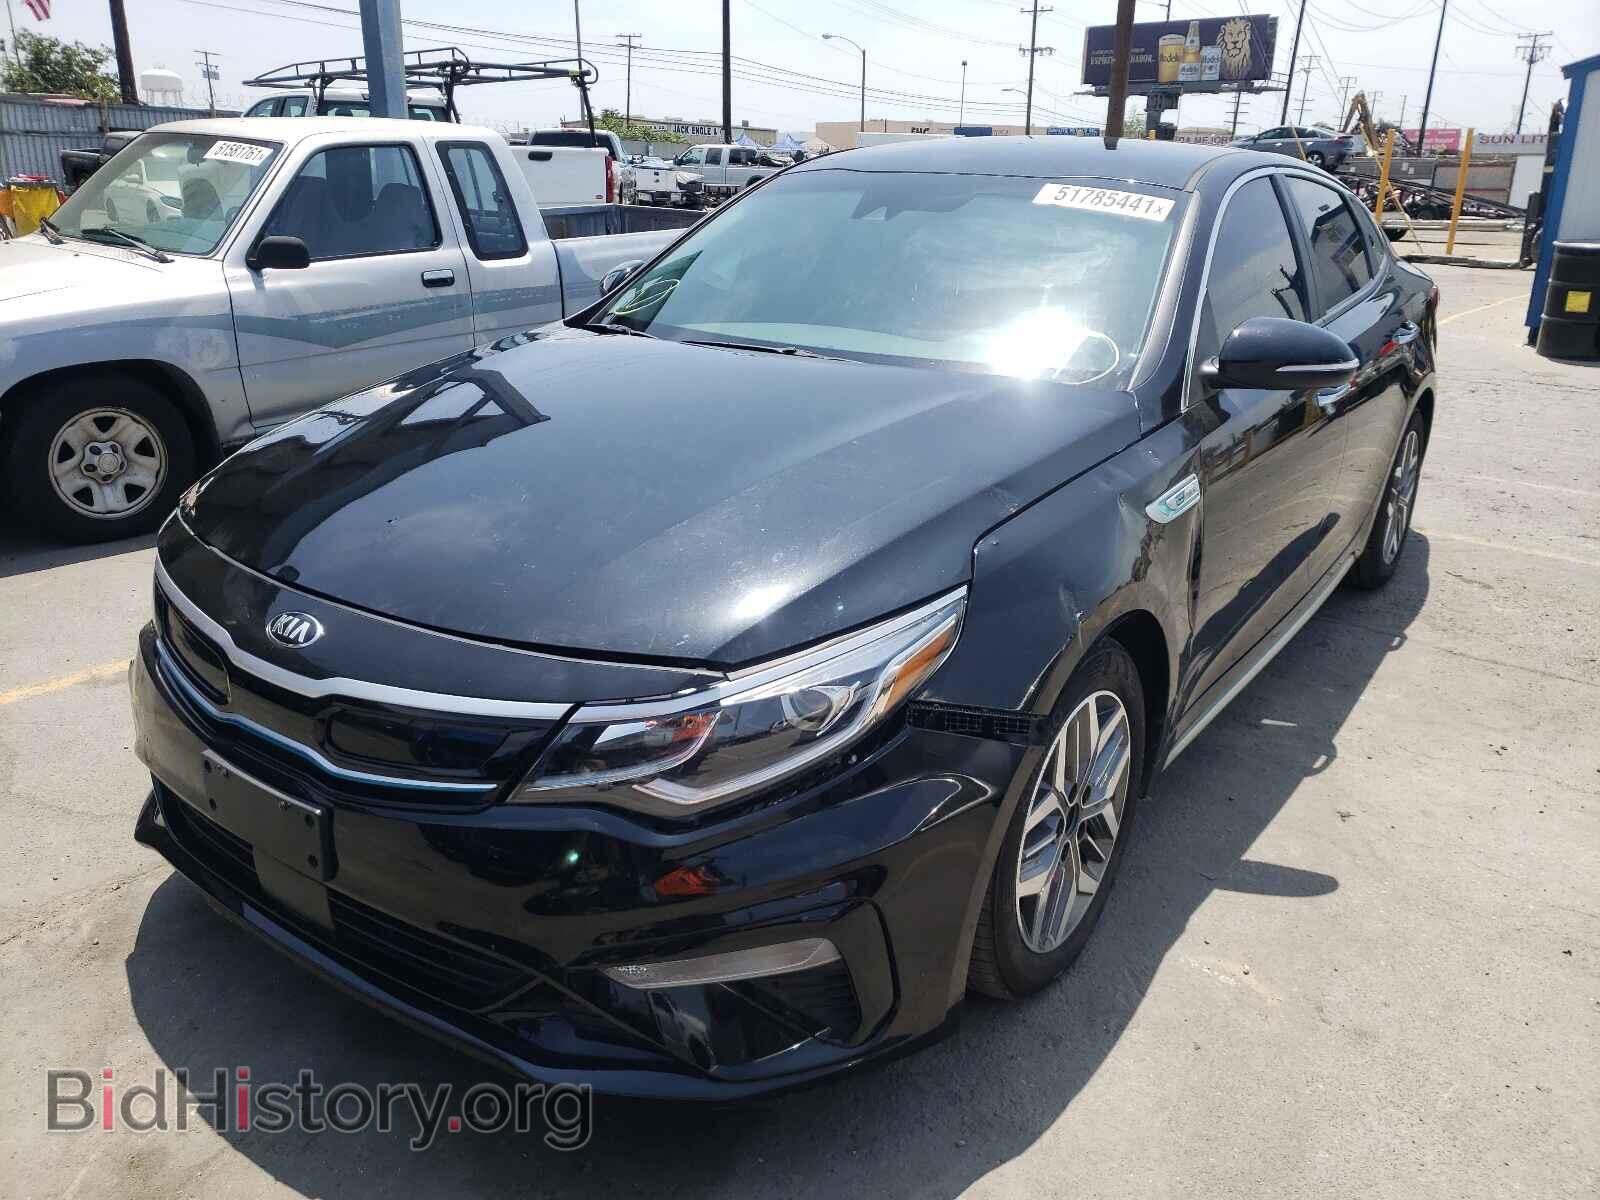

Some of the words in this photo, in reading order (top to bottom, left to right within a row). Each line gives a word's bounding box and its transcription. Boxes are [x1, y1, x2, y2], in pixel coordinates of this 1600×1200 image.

[673, 125, 689, 134] JACK
[1479, 133, 1514, 145] SUN
[272, 614, 311, 643] KIA
